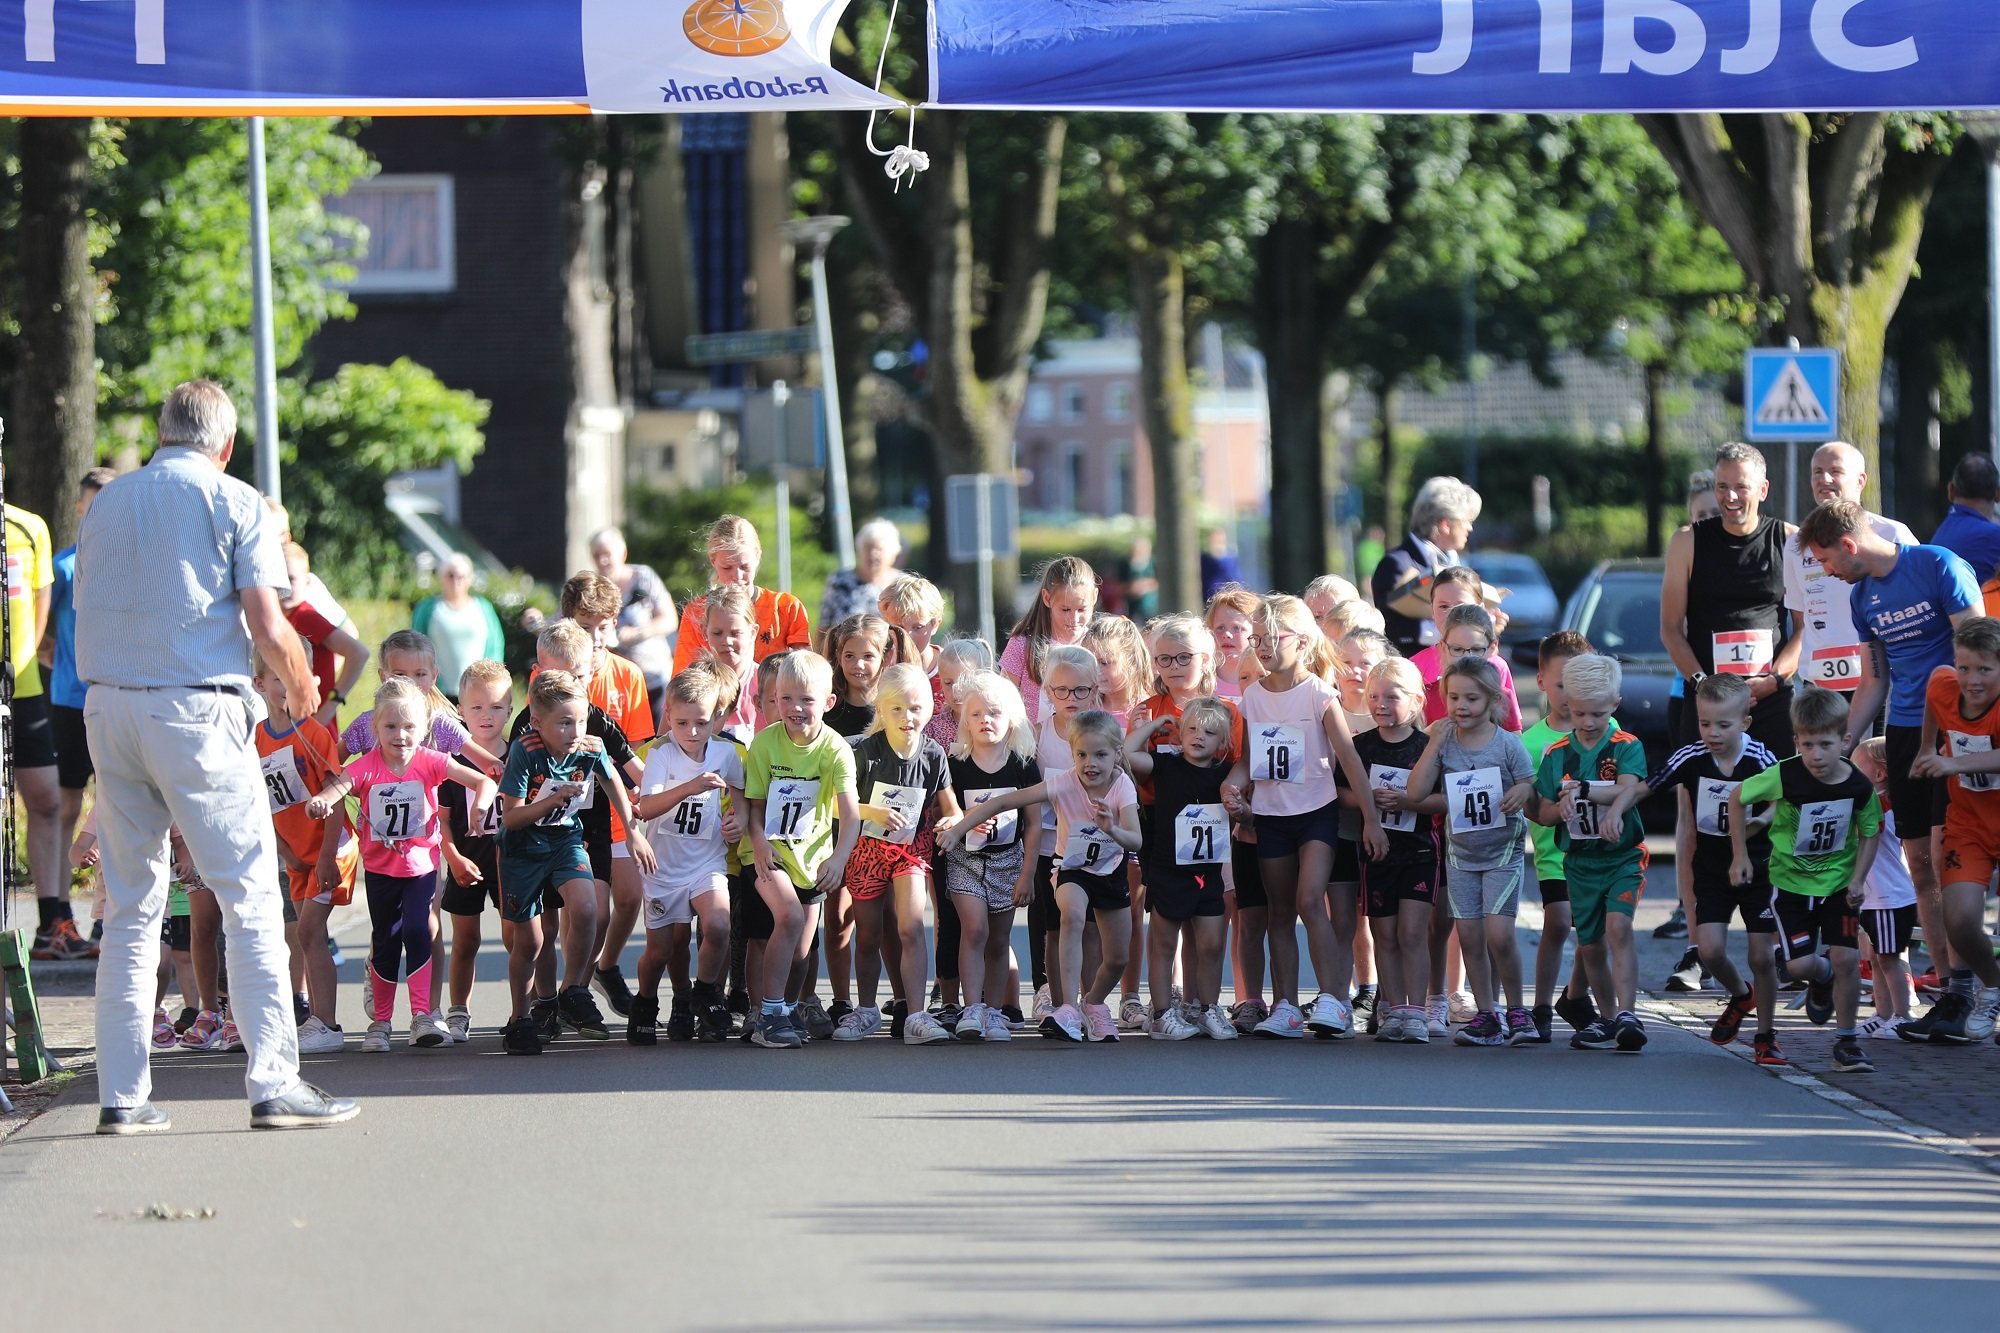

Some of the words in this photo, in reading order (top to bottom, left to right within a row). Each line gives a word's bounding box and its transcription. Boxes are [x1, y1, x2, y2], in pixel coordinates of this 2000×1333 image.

[1876, 600, 1932, 627] Haan
[1731, 645, 1756, 662] 17
[1822, 659, 1850, 678] 30
[1266, 745, 1290, 780] 19
[265, 770, 296, 806] 31
[384, 796, 417, 804] Onstwedde
[1462, 784, 1495, 793] Onstwedde
[674, 801, 704, 835] 45
[779, 802, 803, 835] 17
[885, 799, 915, 809] Onstwedde
[1464, 791, 1492, 826] 43
[1814, 814, 1845, 822] Onstwedde
[385, 803, 410, 837] 27
[1191, 825, 1214, 861] 21
[1809, 820, 1838, 851] 35
[1084, 842, 1101, 867] 9
